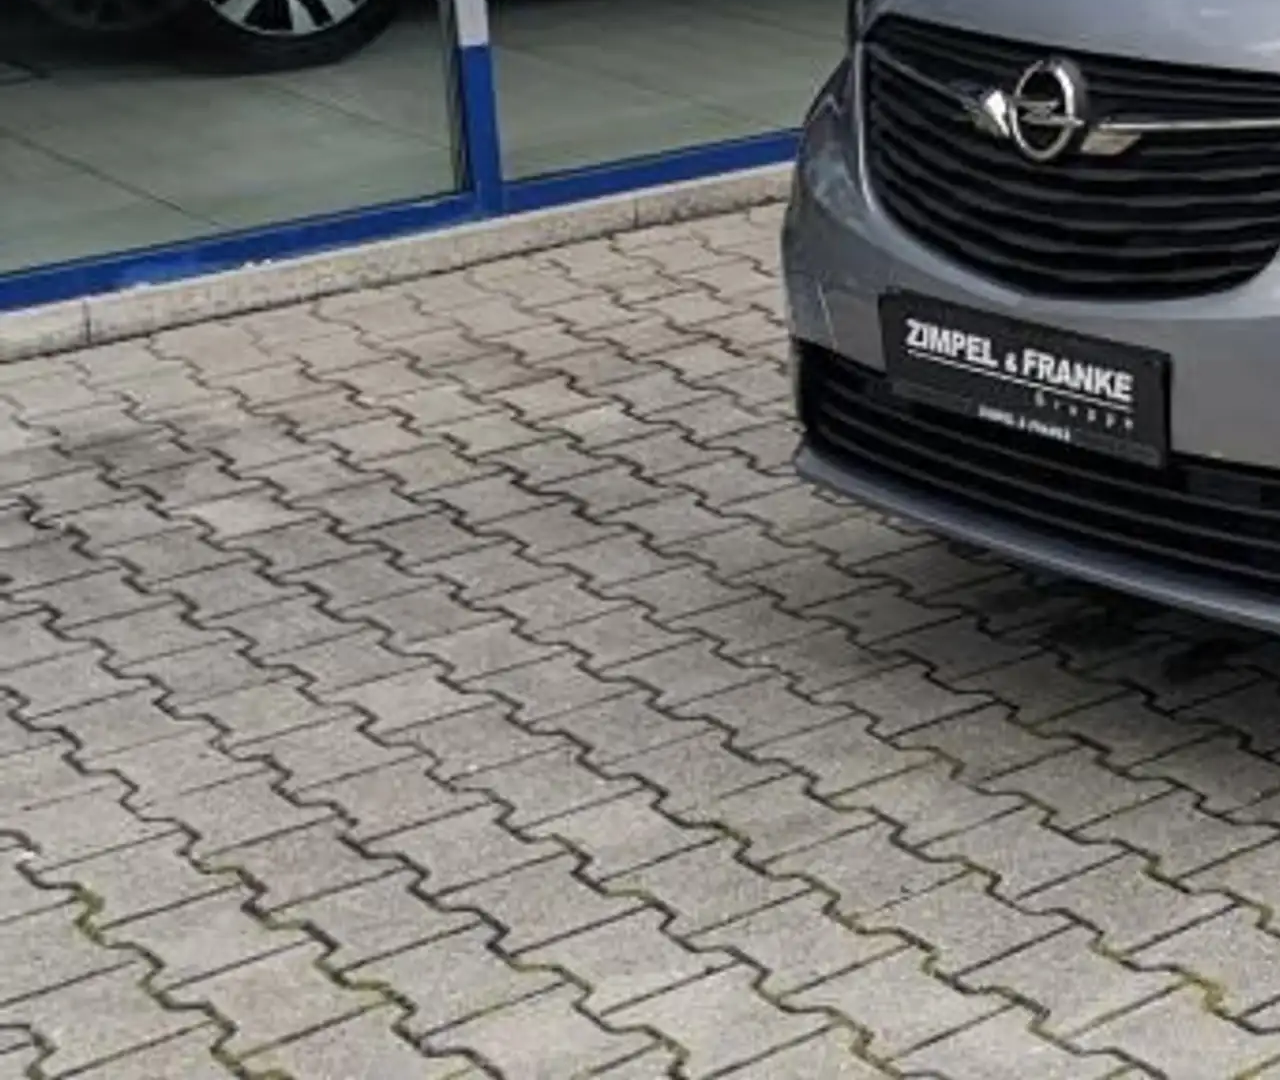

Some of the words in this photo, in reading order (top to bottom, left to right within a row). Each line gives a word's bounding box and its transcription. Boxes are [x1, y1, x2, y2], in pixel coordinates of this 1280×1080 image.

[905, 317, 998, 368] ZIMPEL
[1004, 351, 1018, 374] &
[1021, 347, 1135, 403] FRANKE
